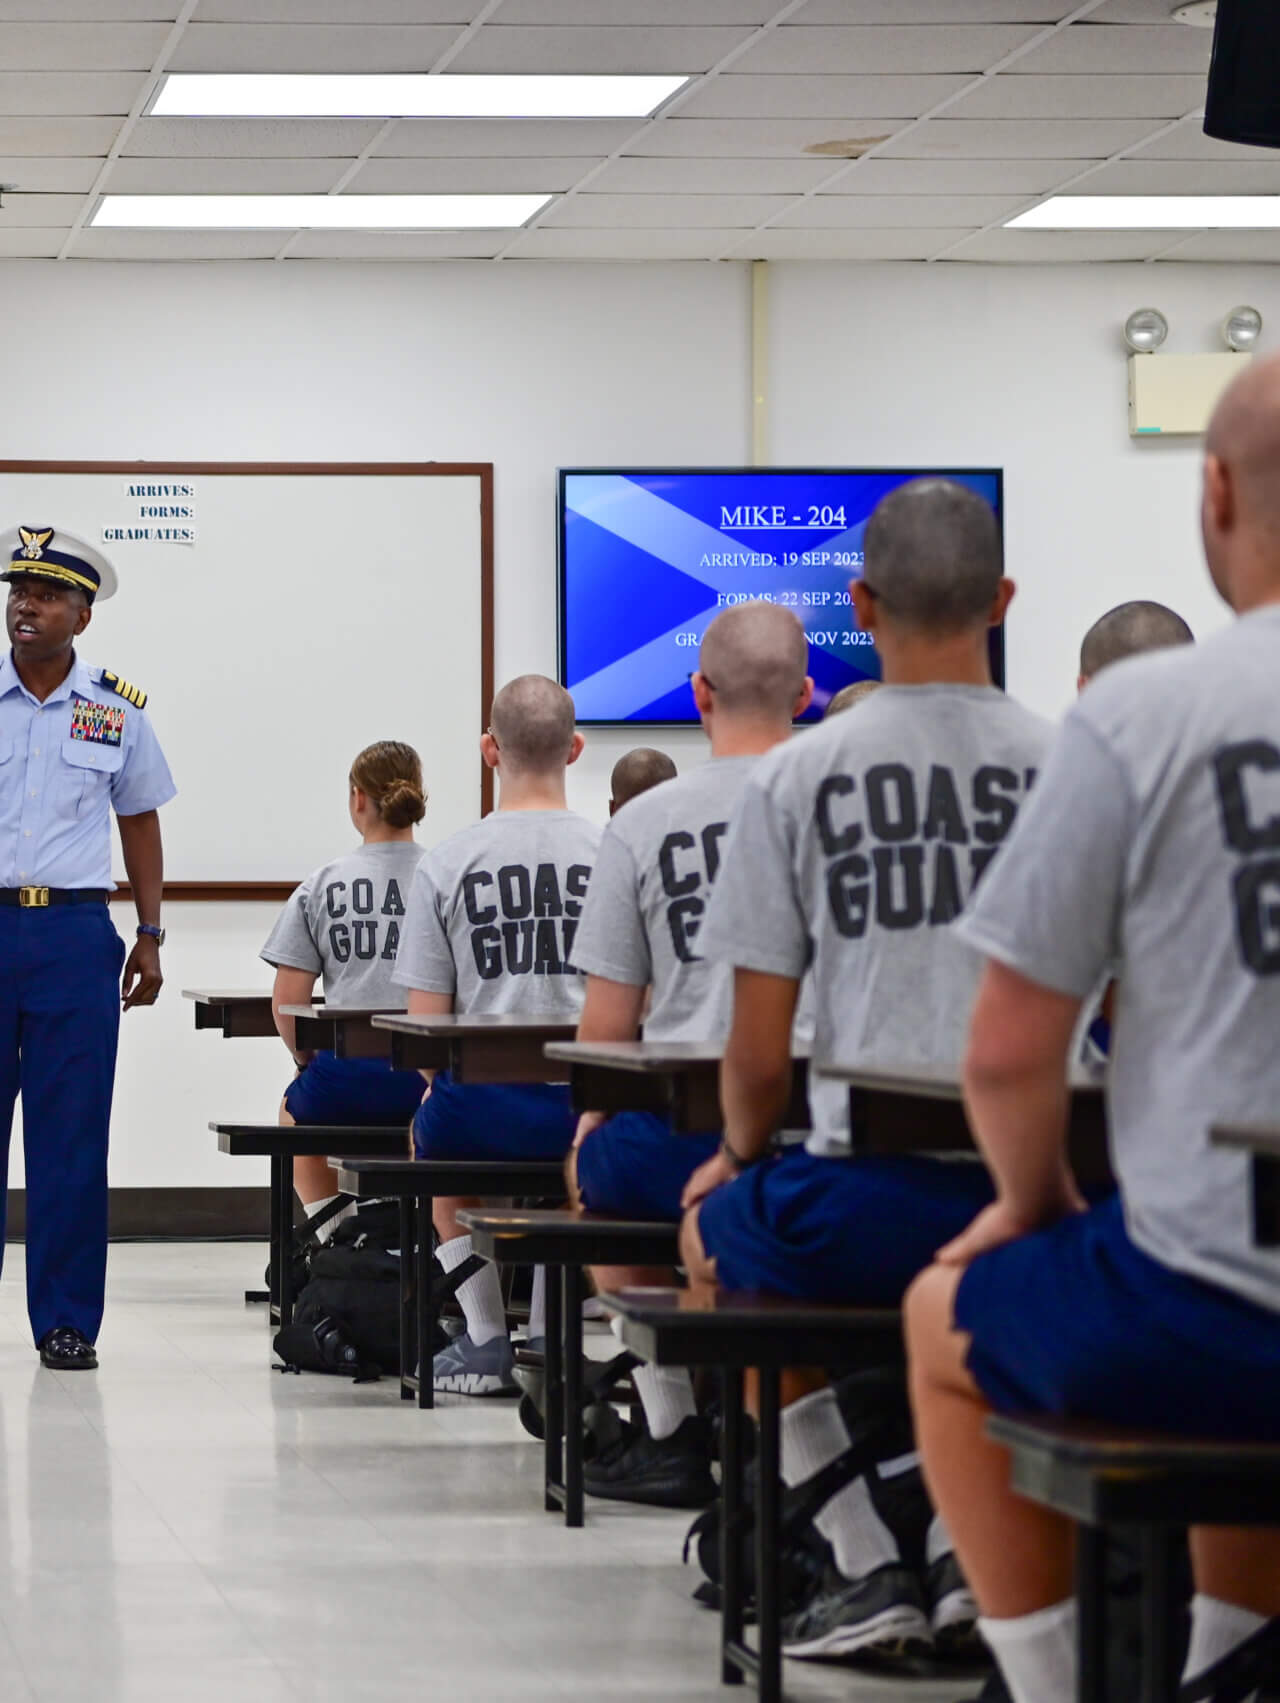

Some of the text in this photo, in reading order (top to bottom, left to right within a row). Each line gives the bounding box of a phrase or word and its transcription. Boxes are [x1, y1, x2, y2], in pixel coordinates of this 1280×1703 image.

[126, 485, 194, 497] ARRIVES:
[140, 506, 193, 518] FORMS:
[720, 505, 786, 526] MIKE
[807, 505, 847, 526] 204
[104, 528, 194, 540] GRADUATES:
[699, 552, 777, 567] ARRIVED:
[783, 552, 798, 567] 19
[802, 552, 830, 567] SEP
[781, 592, 799, 606] 22
[802, 592, 830, 606] SEP
[803, 632, 874, 646] NOV 2023
[816, 762, 1037, 856] COAS
[326, 878, 406, 919] COA
[463, 863, 592, 925] COAS
